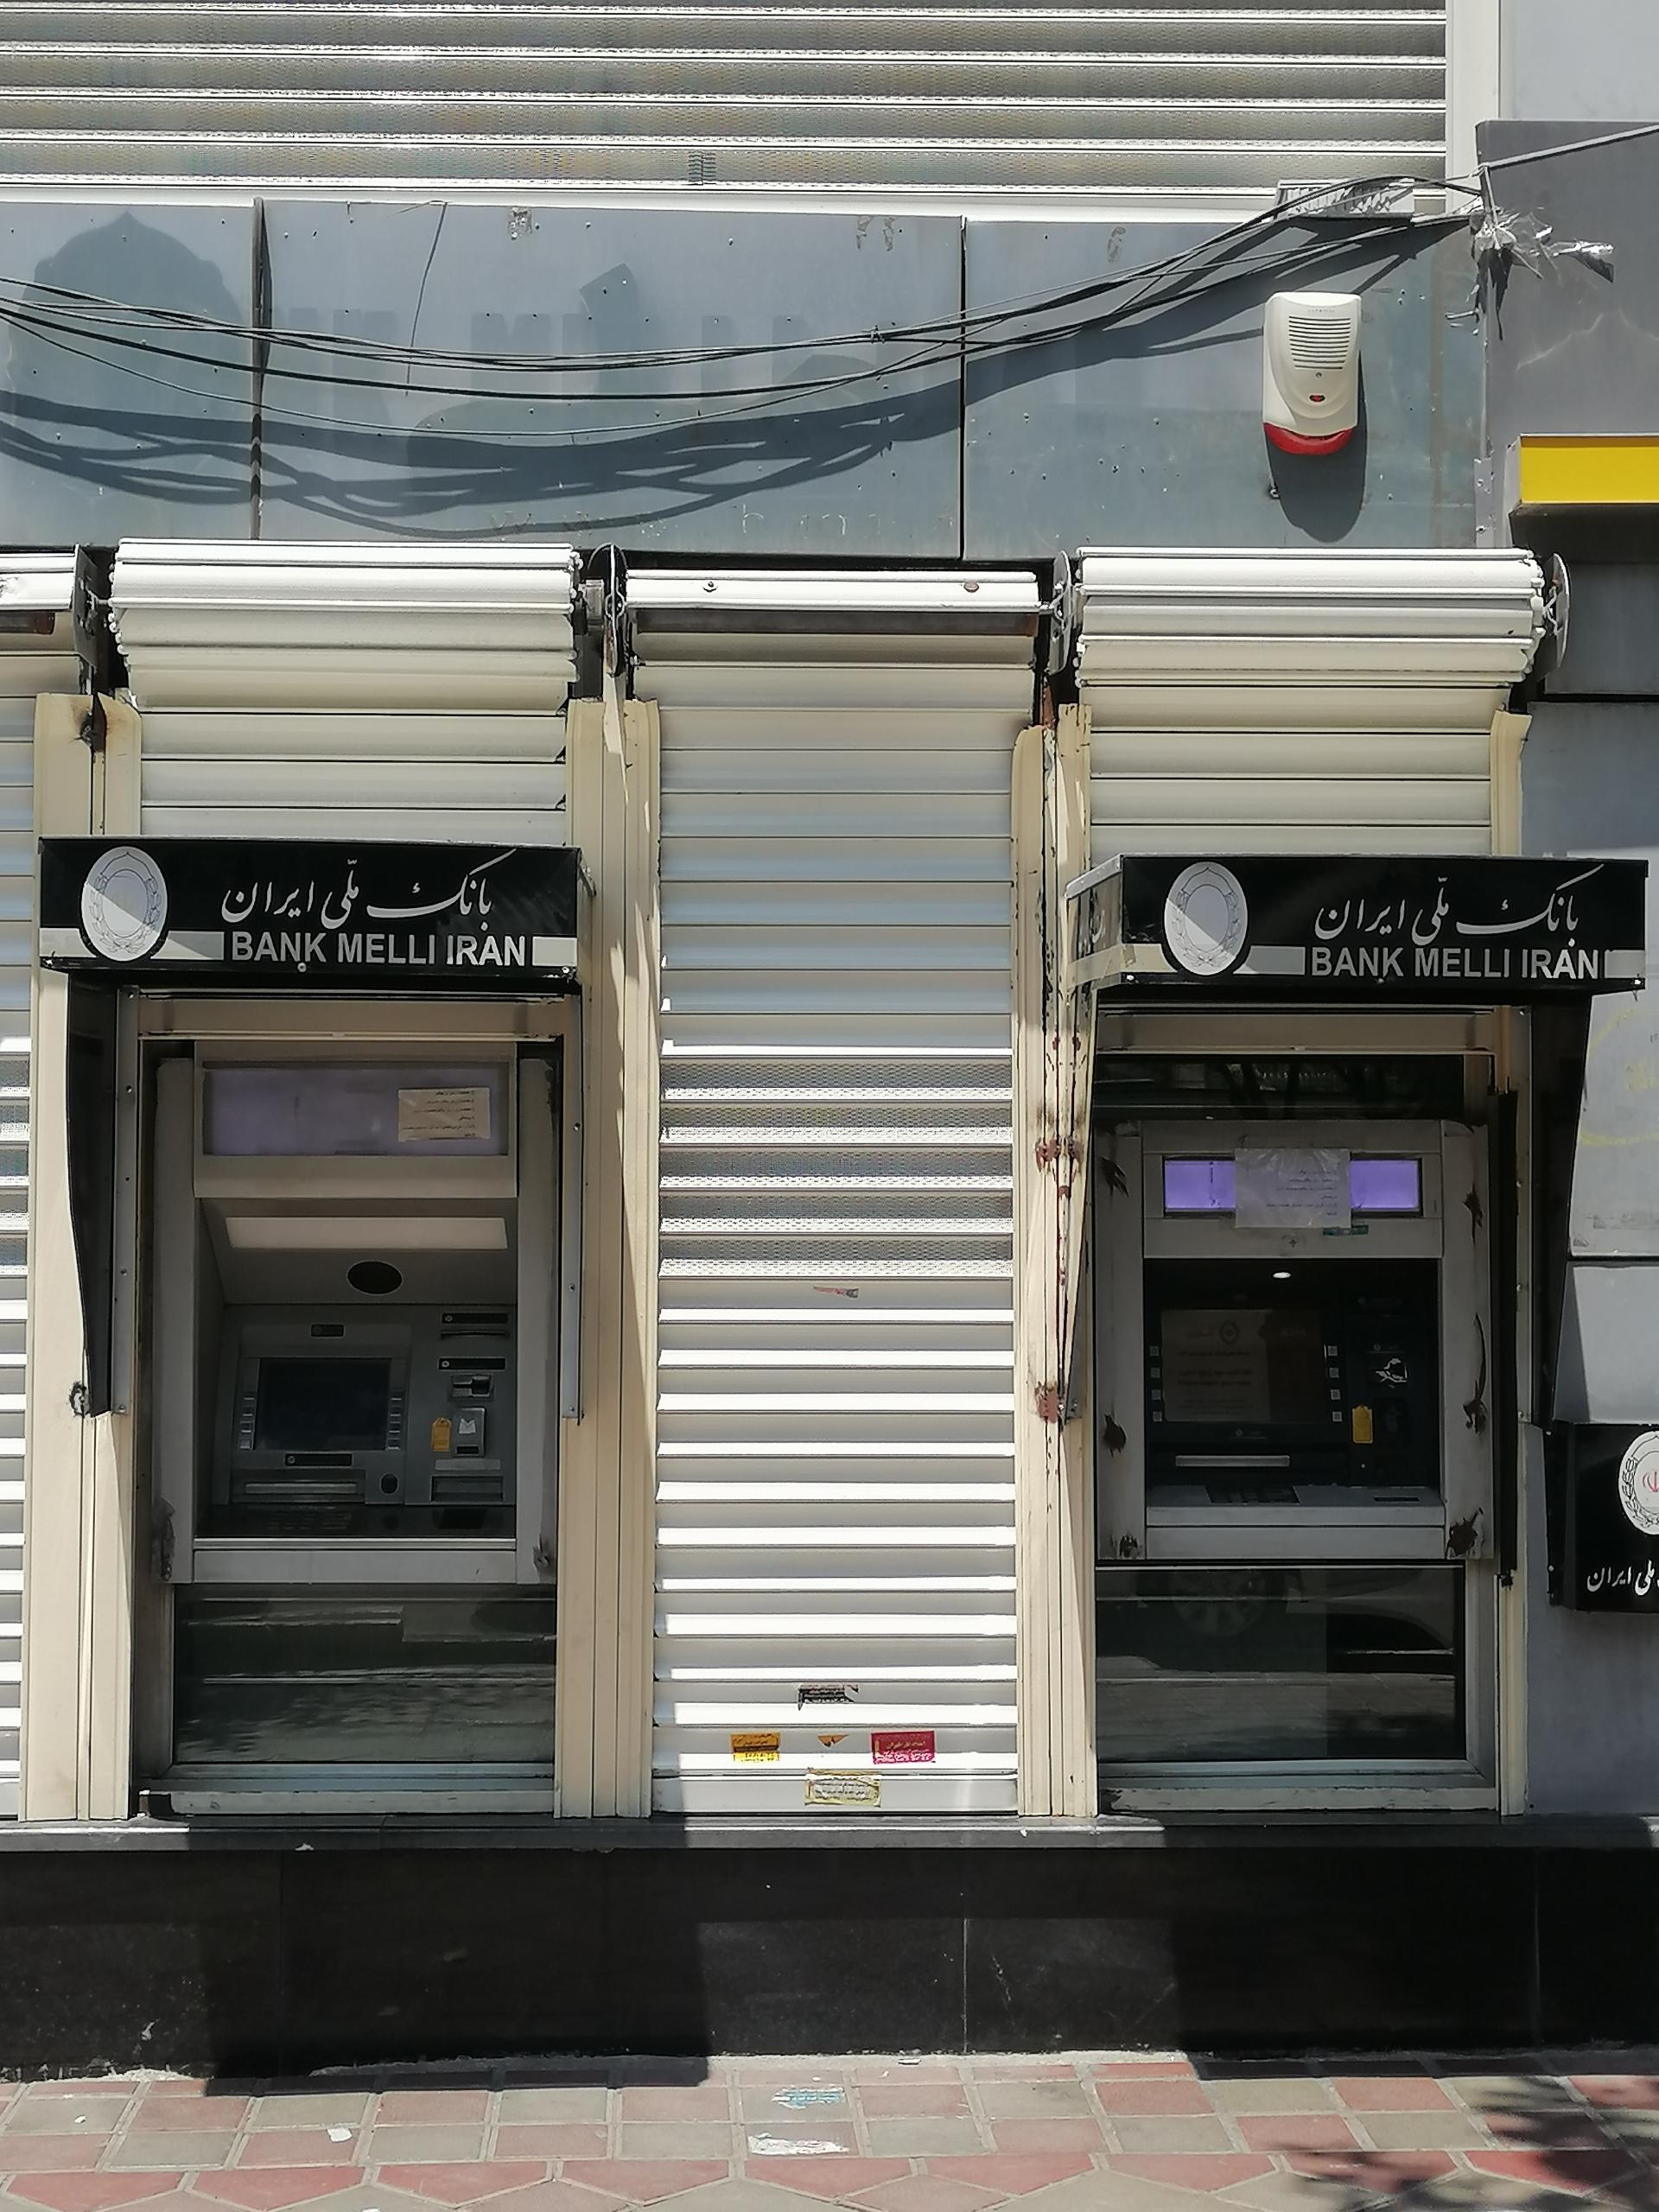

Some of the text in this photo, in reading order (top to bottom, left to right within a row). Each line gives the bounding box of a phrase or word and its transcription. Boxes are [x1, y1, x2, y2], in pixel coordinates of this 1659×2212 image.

[221, 880, 315, 923] ایران
[1314, 899, 1406, 940] ایران
[232, 931, 526, 966] BANK MELLI IRAN
[1311, 946, 1599, 979] BANK MELLI IRAN
[1586, 1566, 1632, 1592] ایران
